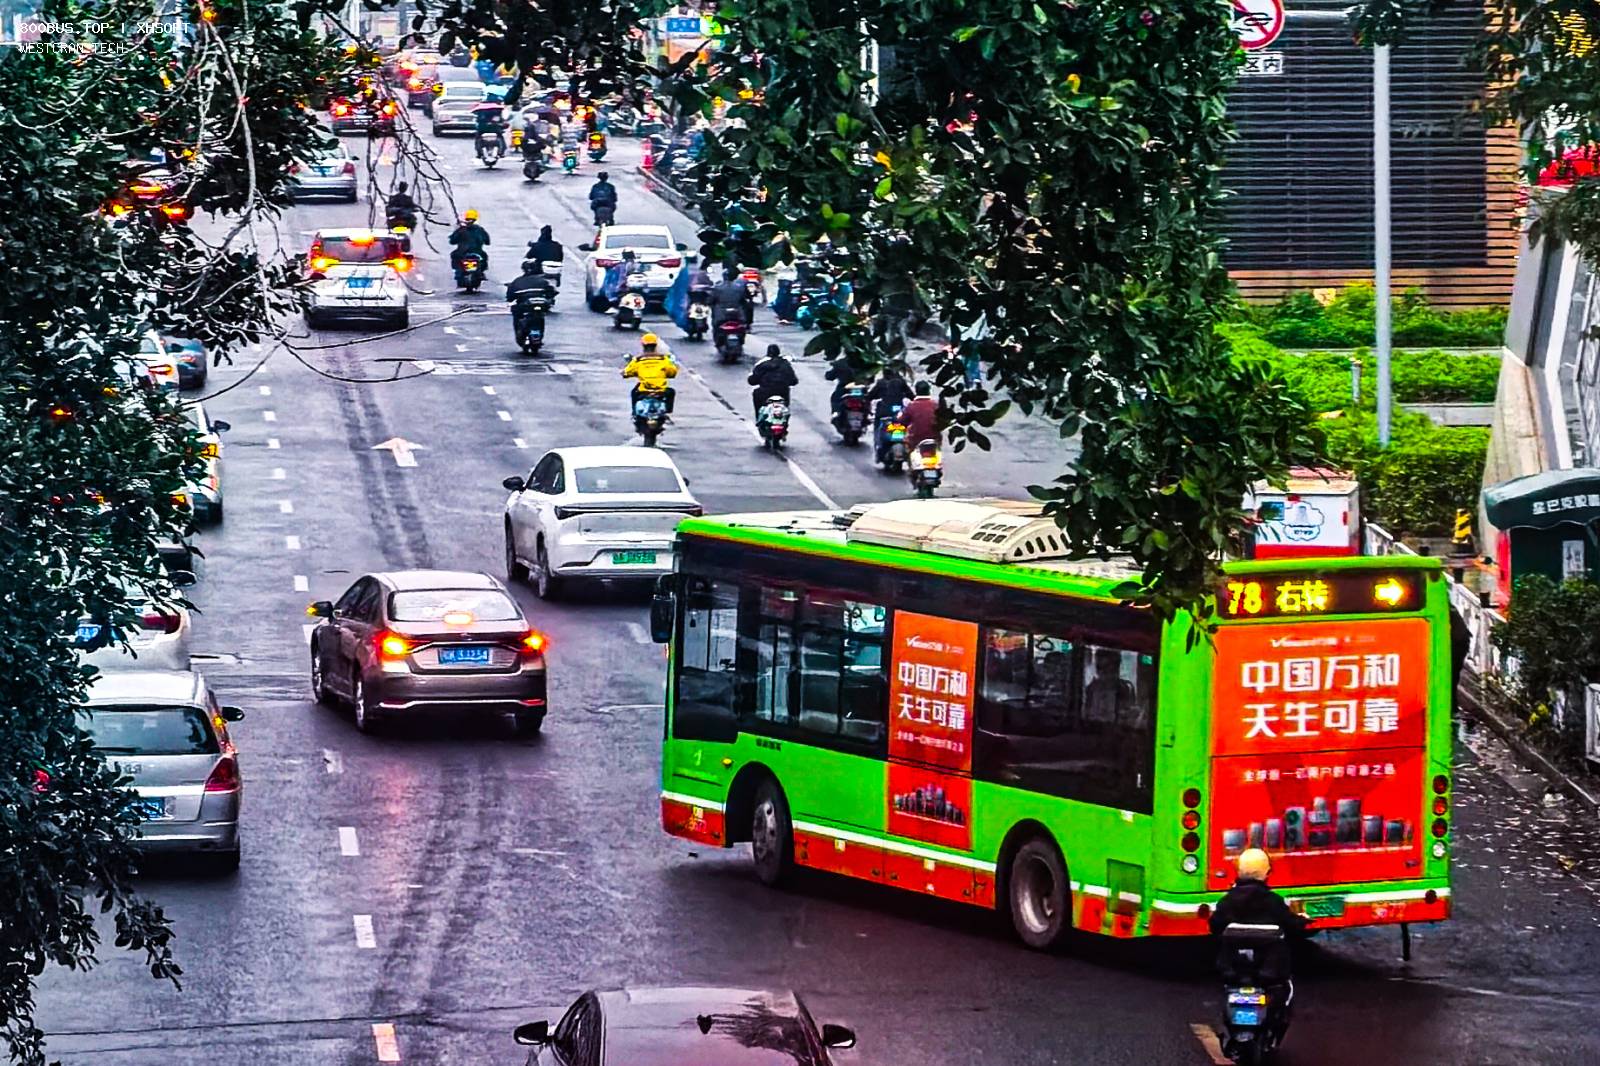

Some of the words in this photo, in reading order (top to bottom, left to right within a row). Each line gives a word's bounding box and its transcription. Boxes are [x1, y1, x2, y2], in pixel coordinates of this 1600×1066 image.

[1228, 582, 1262, 614] 78
[1276, 580, 1328, 613] 右转
[899, 661, 967, 697] 中国万和
[1242, 654, 1400, 693] 中国万和
[898, 692, 966, 730] 天生可靠
[1243, 698, 1399, 738] 天生可靠
